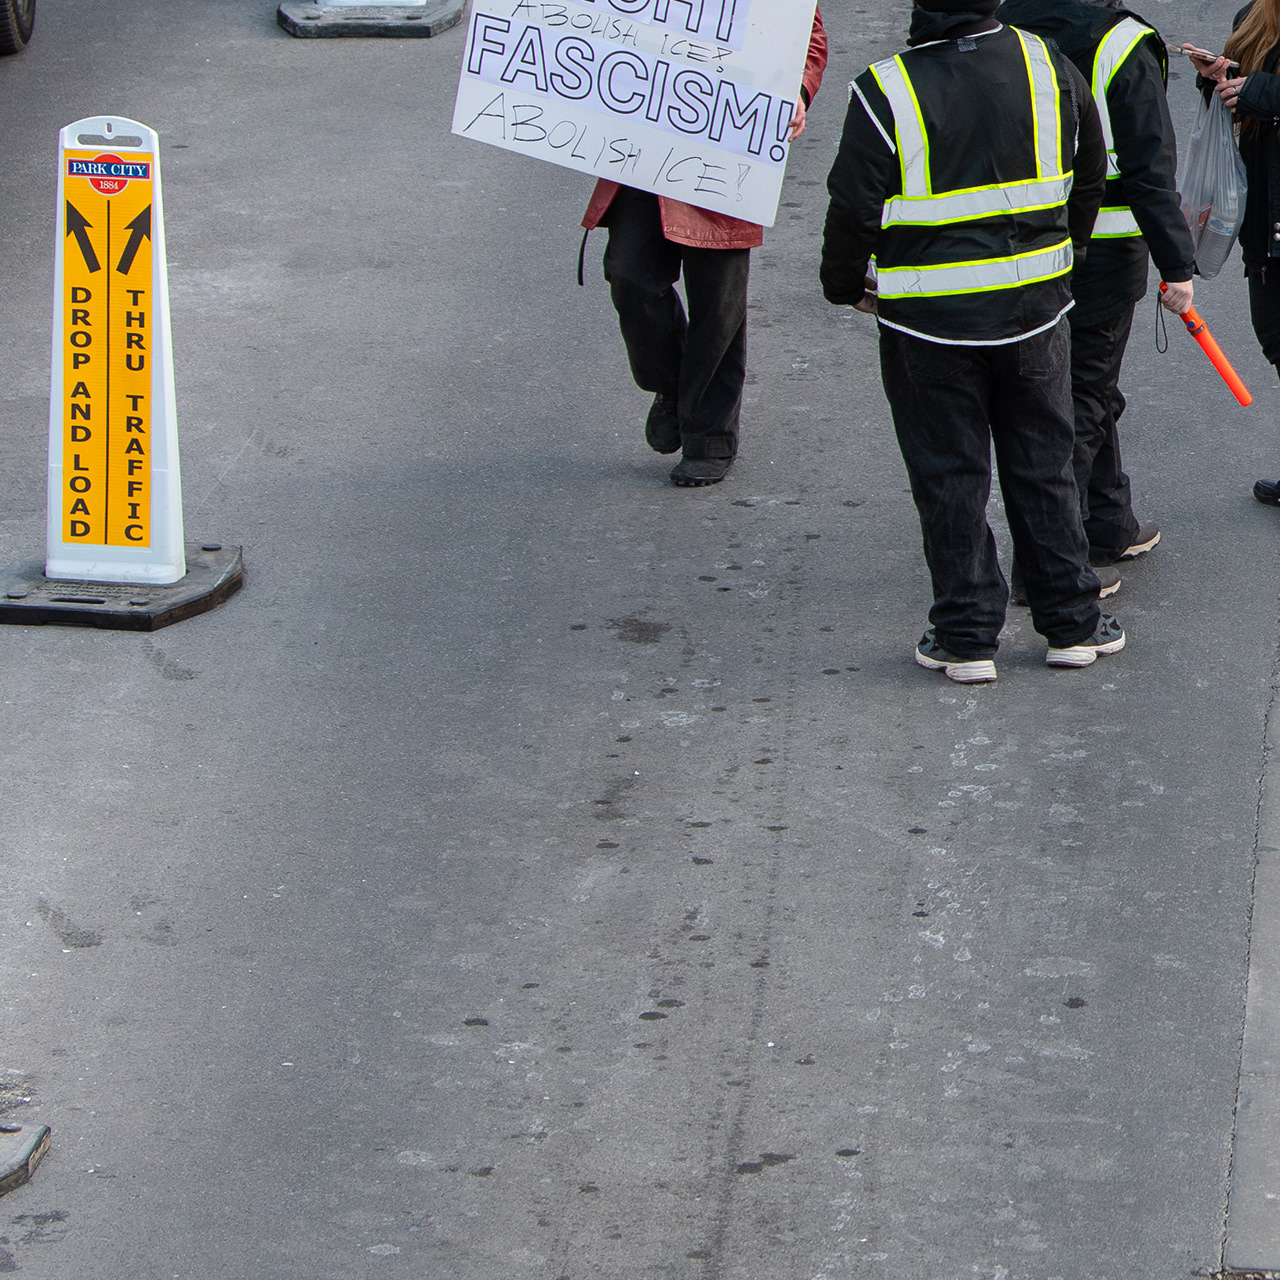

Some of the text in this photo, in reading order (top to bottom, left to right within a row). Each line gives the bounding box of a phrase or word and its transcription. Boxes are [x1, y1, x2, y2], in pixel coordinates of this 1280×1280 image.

[463, 93, 644, 174] ABOLISH
[468, 13, 794, 164] FASCISM!
[72, 162, 146, 177] PARK CITY
[100, 180, 118, 190] 1884
[70, 287, 92, 537] DROP AND LOAD
[125, 290, 146, 541] THRU TRAFFIC
